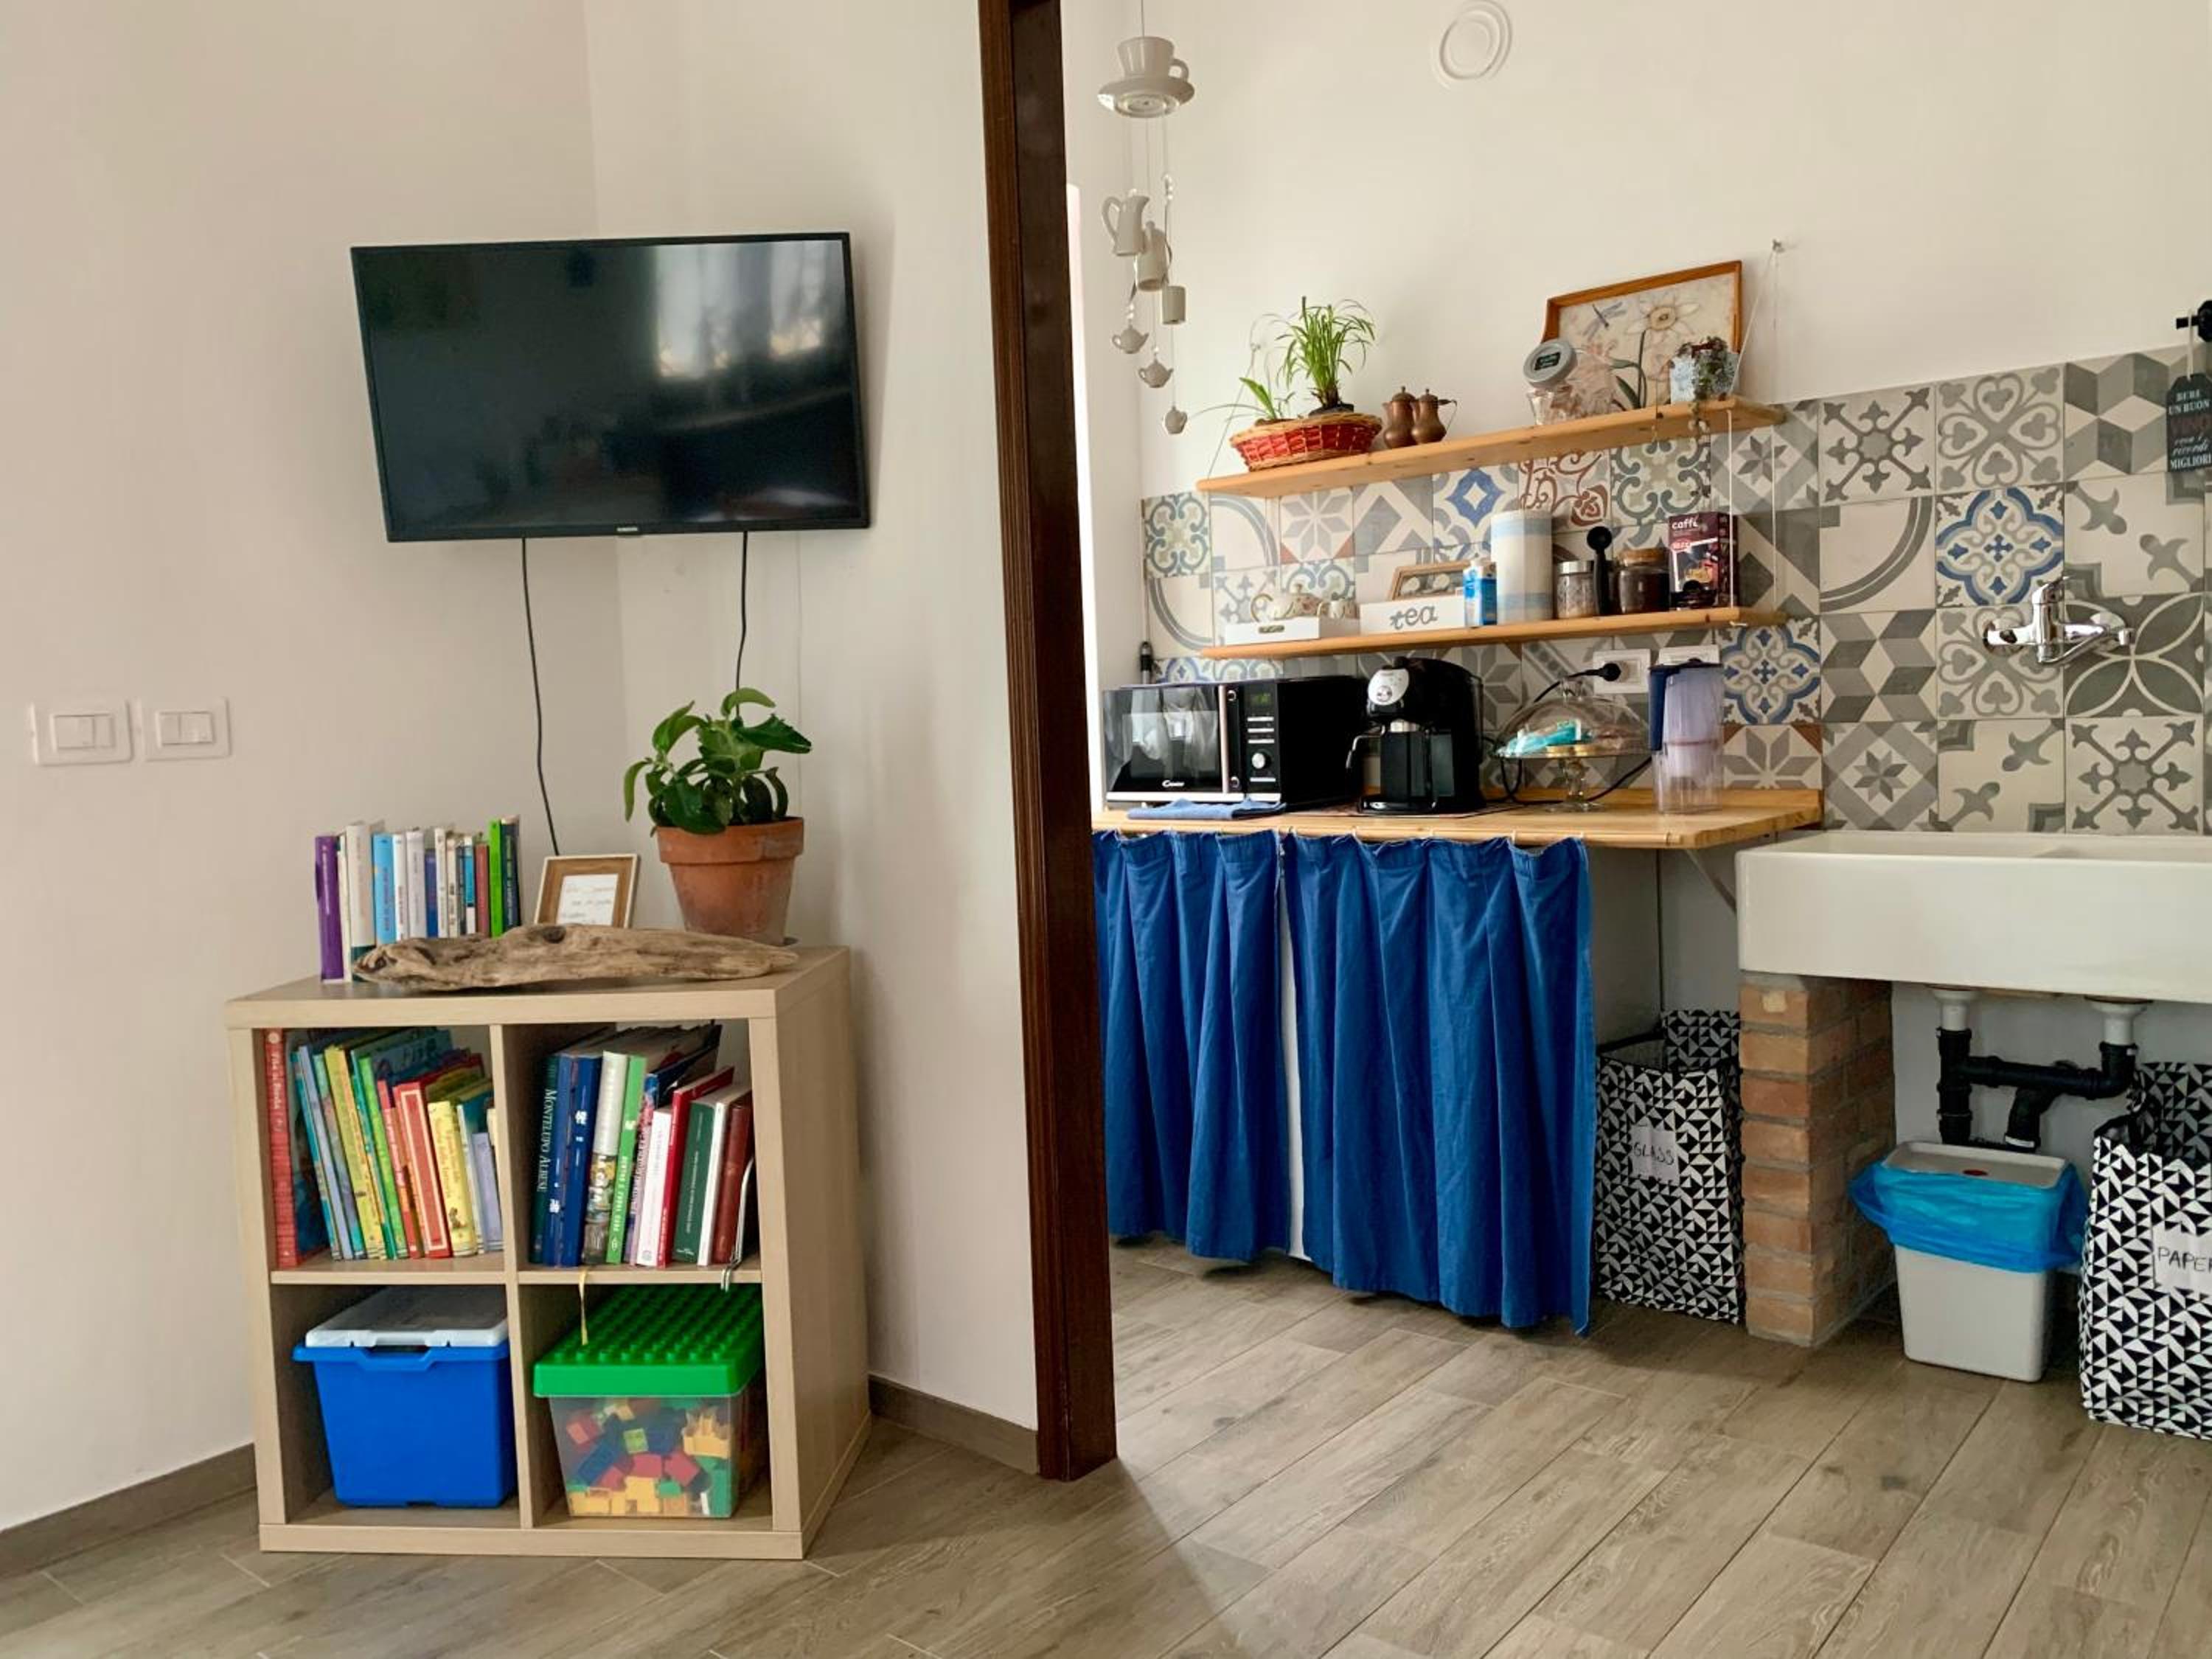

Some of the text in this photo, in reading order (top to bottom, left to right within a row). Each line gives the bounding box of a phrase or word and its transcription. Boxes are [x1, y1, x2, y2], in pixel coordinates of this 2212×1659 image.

[2170, 453, 2212, 470] MIGLIORI
[1390, 605, 1439, 630] tea
[1633, 1141, 1674, 1166] GLASS
